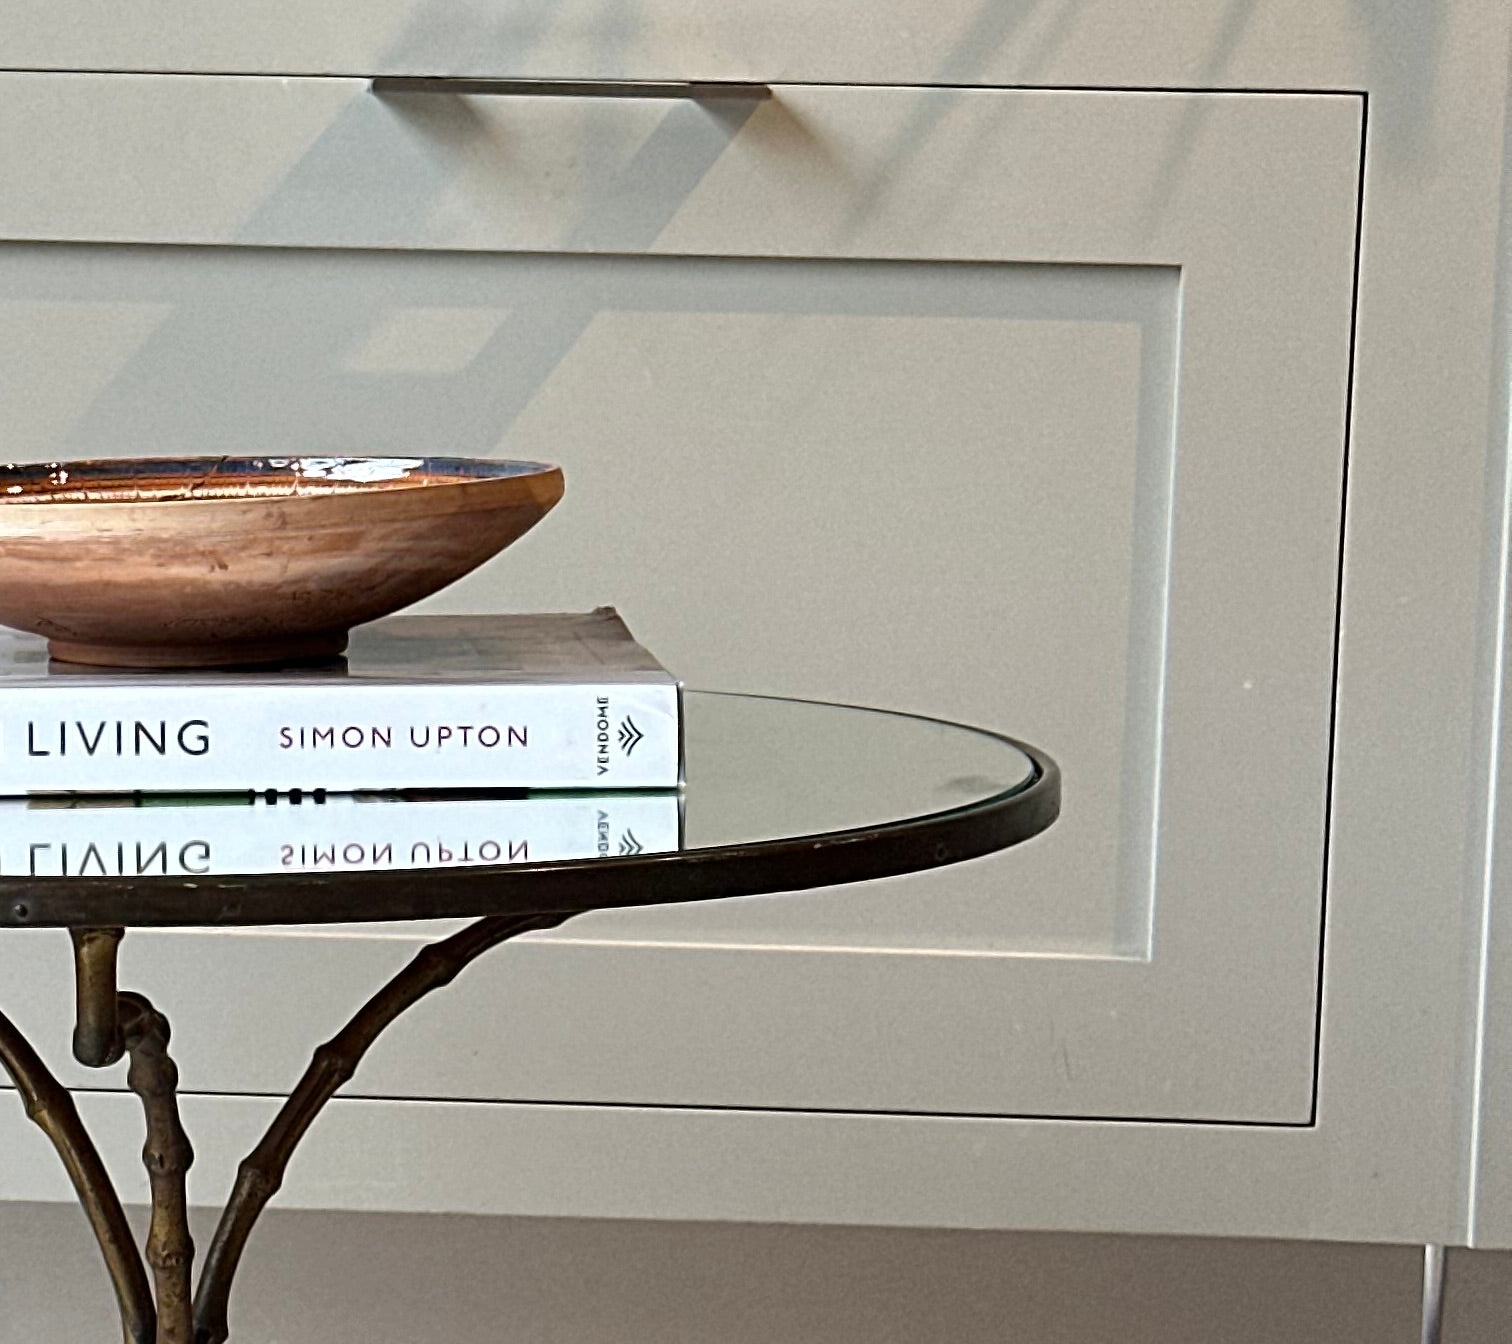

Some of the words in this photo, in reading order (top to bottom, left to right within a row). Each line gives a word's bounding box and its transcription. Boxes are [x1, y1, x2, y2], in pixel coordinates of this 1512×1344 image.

[28, 720, 210, 757] LIVING
[280, 726, 392, 749] SIMON
[410, 726, 528, 748] UPTON
[597, 696, 609, 776] VENDOME
